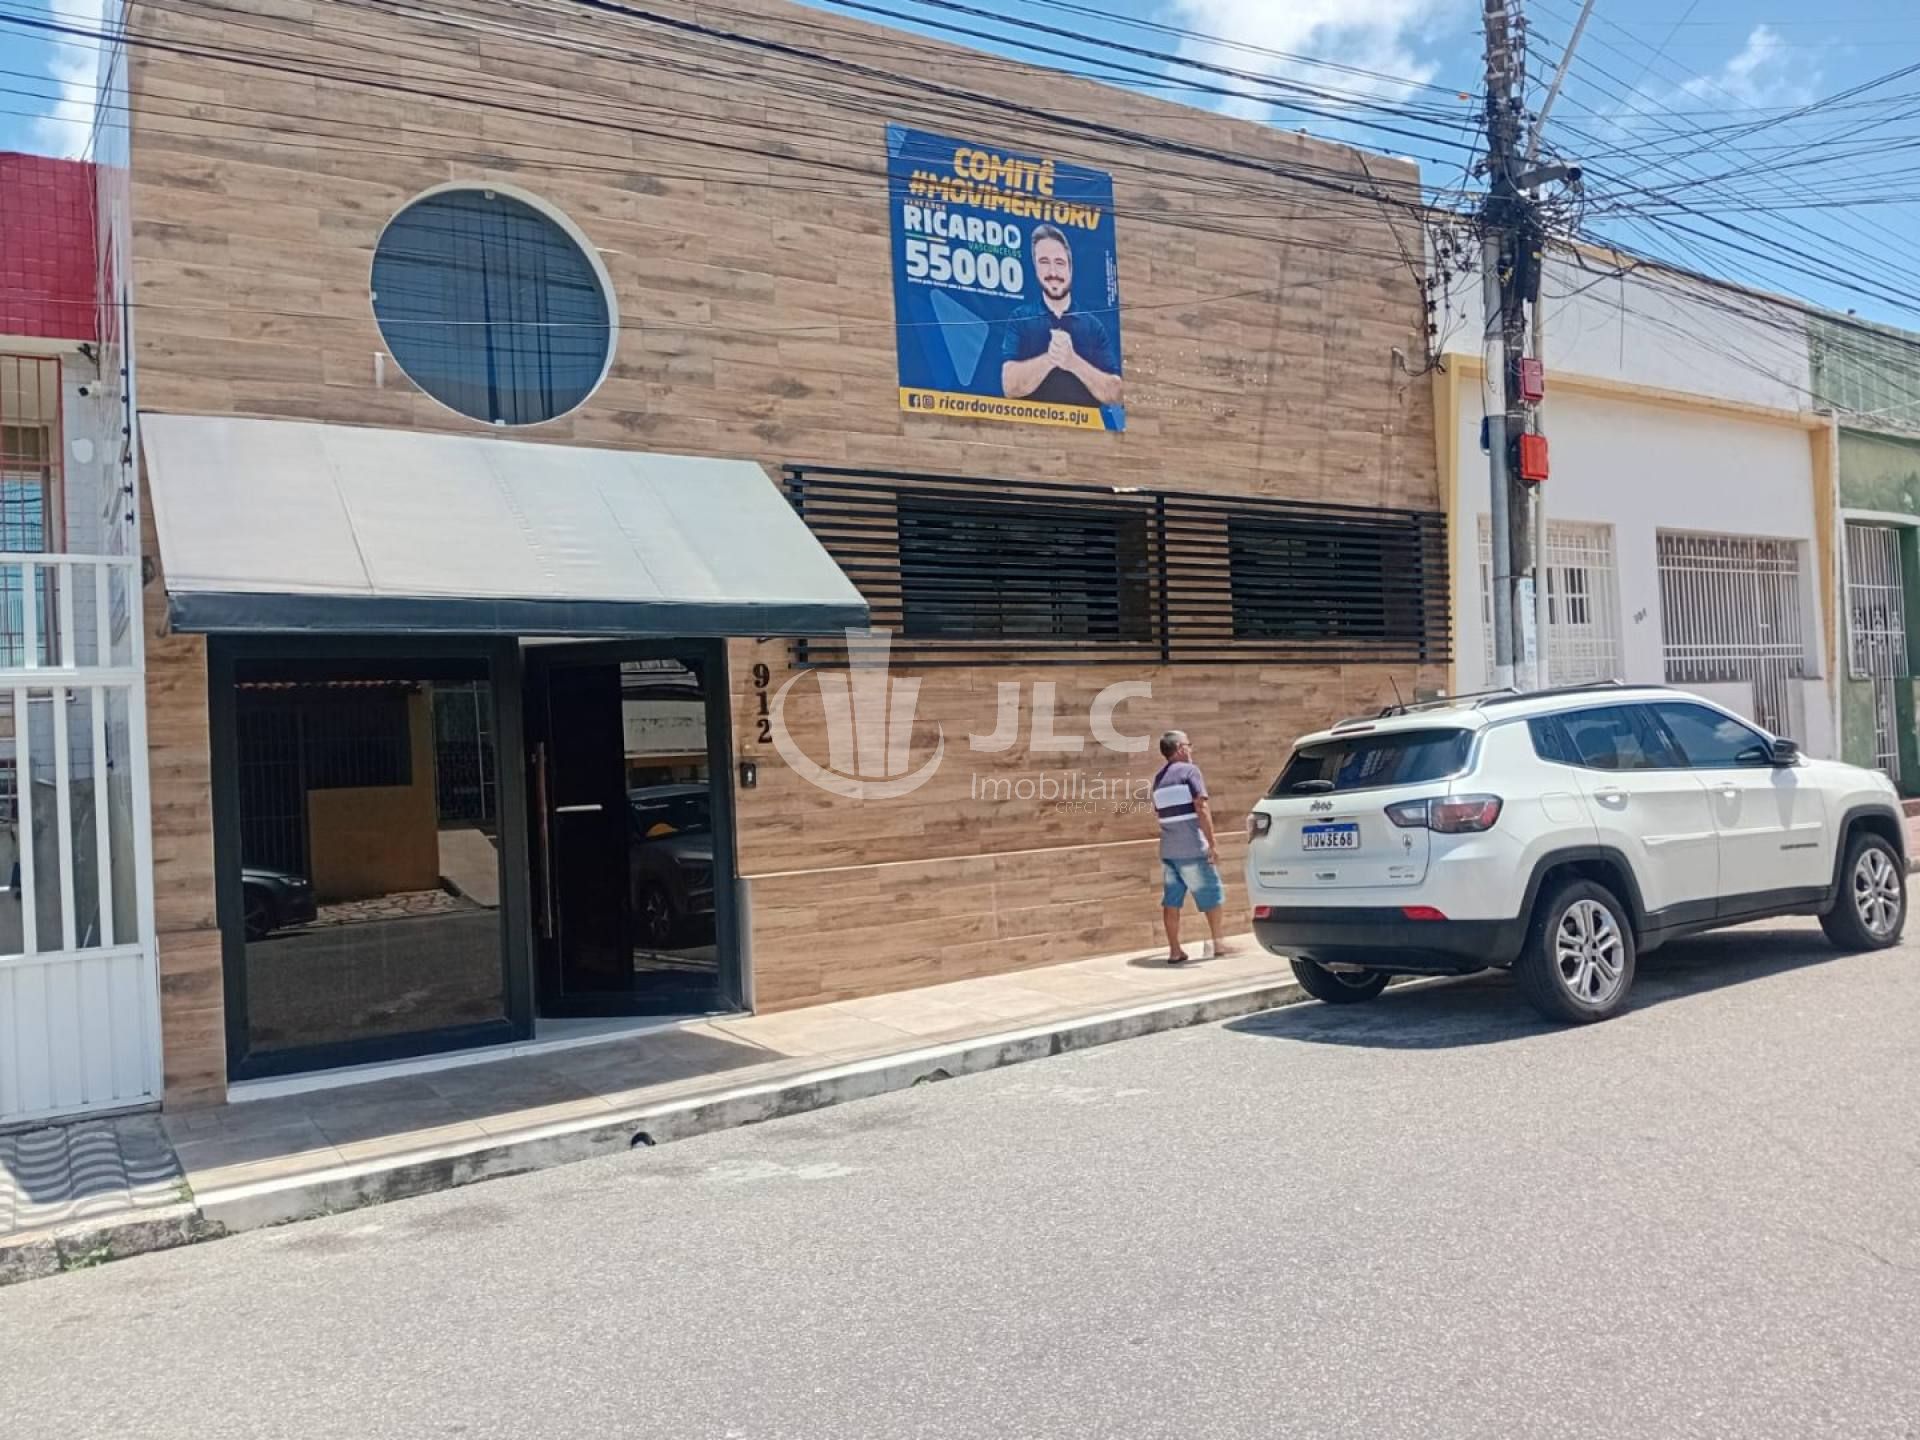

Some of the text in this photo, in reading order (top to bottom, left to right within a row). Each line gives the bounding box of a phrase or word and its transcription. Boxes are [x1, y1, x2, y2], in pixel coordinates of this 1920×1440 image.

[953, 147, 1056, 196] COMITÊ
[908, 170, 1101, 231] #MOVIMENTORV
[903, 205, 1022, 249] RICARDO
[905, 239, 1024, 293] 55000
[939, 395, 1089, 426] ricardovasconcelos.aju
